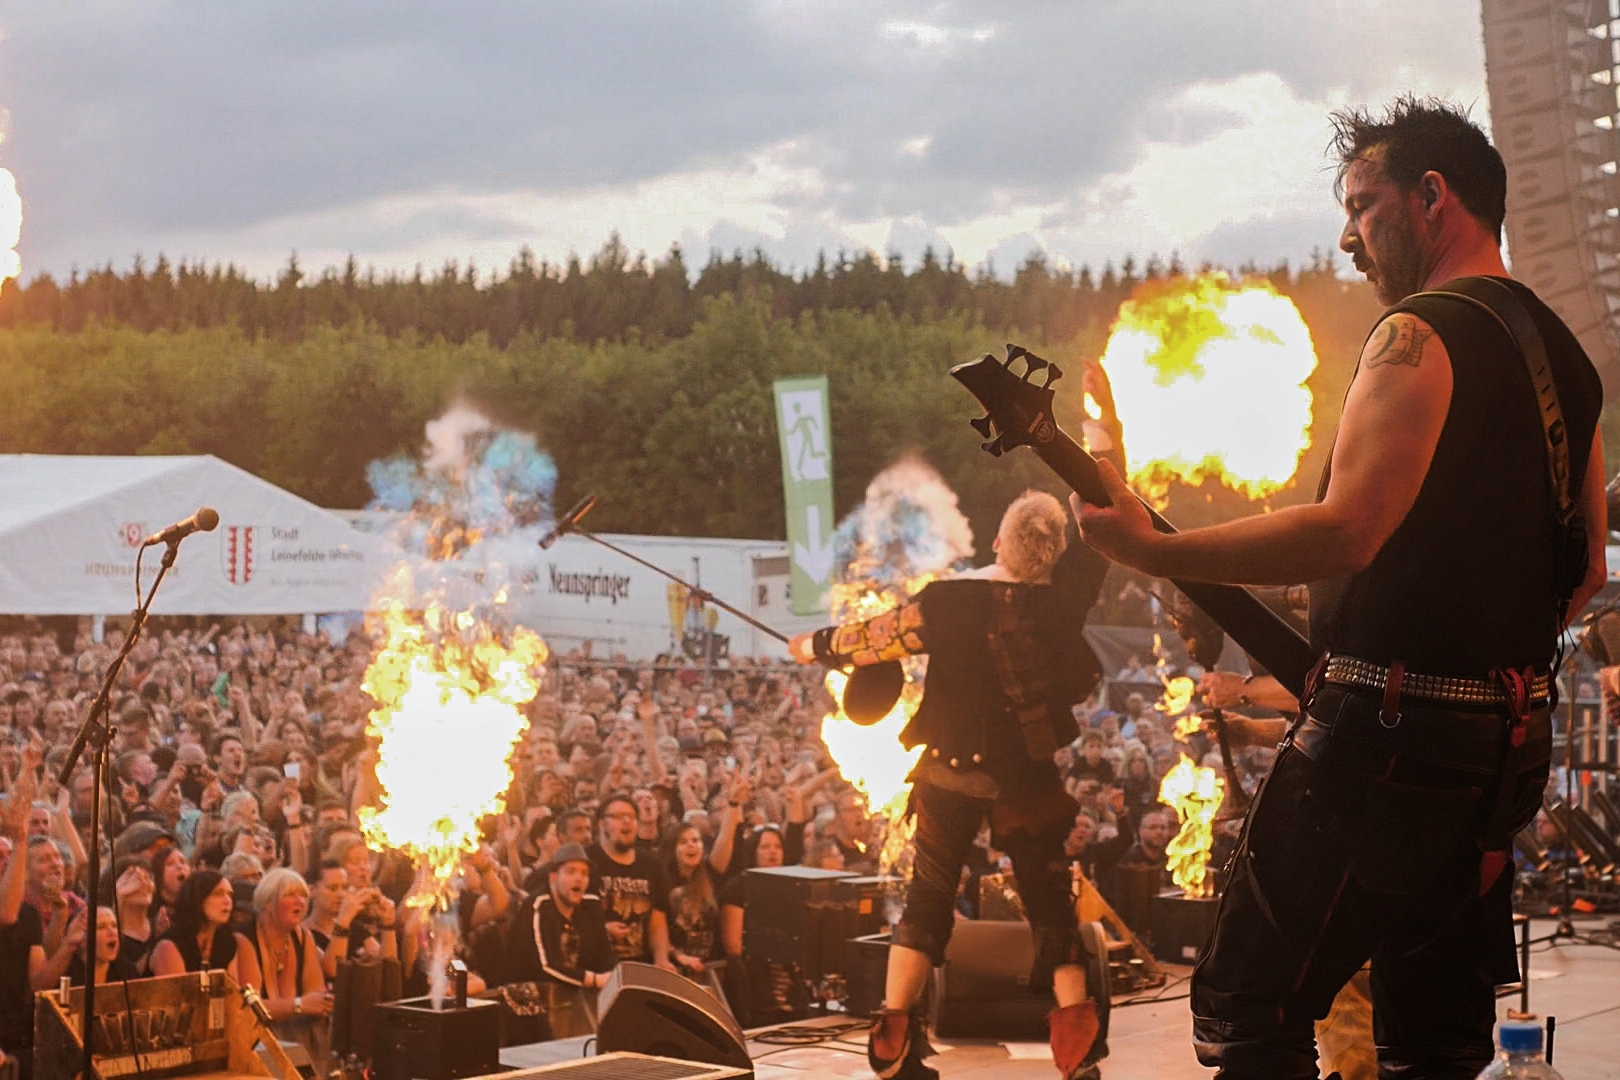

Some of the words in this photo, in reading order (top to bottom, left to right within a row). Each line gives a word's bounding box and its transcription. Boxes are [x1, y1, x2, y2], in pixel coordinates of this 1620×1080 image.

[271, 526, 298, 539] Stadt
[271, 549, 364, 562] Leinefelde-W
[548, 562, 630, 605] Neunspringer
